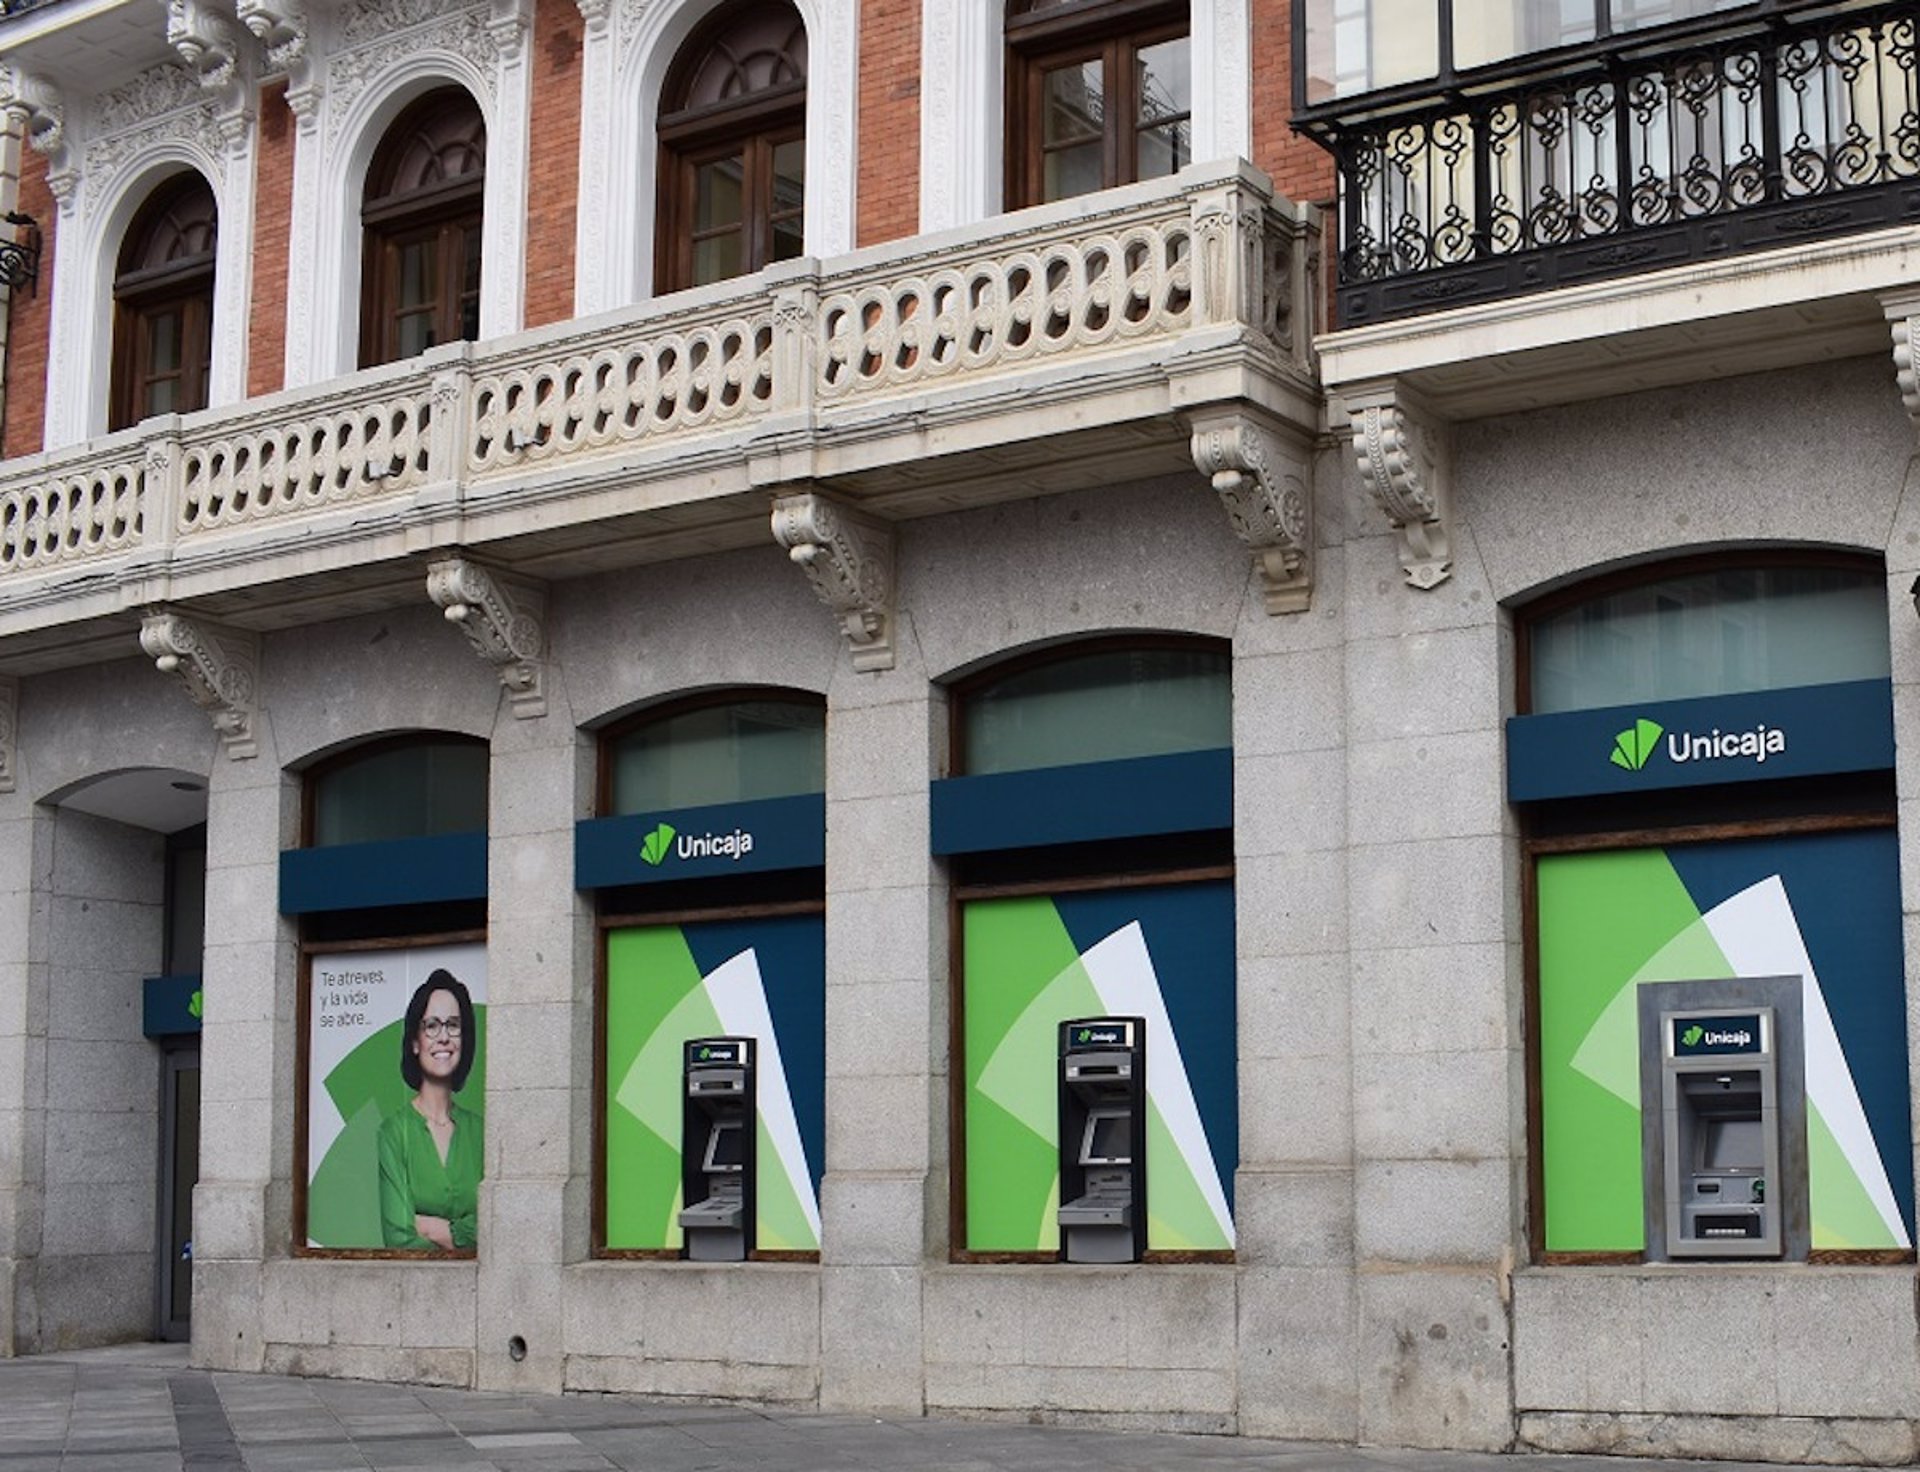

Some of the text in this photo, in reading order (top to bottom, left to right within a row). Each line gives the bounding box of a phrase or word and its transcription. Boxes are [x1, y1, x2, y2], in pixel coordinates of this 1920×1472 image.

[1668, 724, 1785, 762] Unicaja
[678, 829, 752, 859] Unicaja
[321, 972, 335, 986] Te
[320, 990, 368, 1011] y la vida
[320, 1015, 335, 1027] se
[1705, 1030, 1751, 1047] Unicaja
